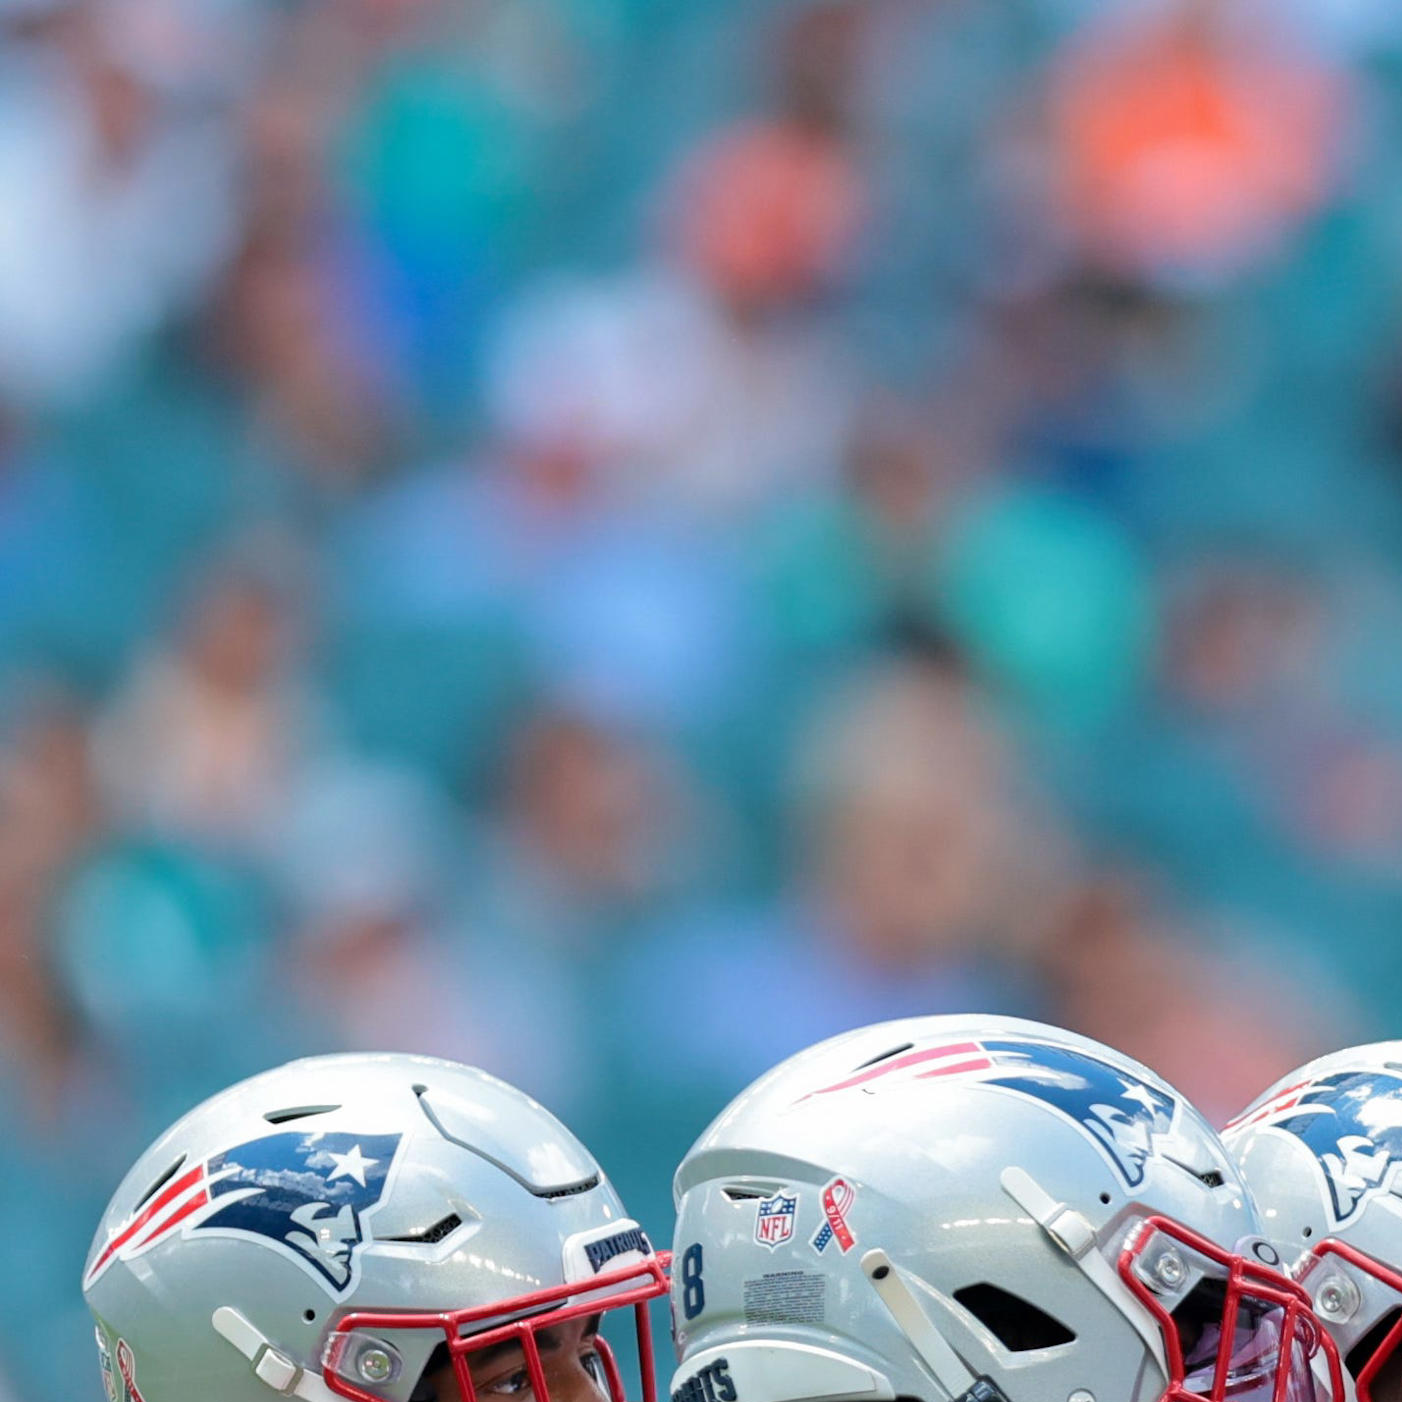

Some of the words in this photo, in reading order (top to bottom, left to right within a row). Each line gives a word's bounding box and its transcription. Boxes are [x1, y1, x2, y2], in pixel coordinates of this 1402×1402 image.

[758, 1215, 790, 1241] NFL
[826, 1205, 844, 1231] 9/11
[682, 1242, 705, 1321] 8
